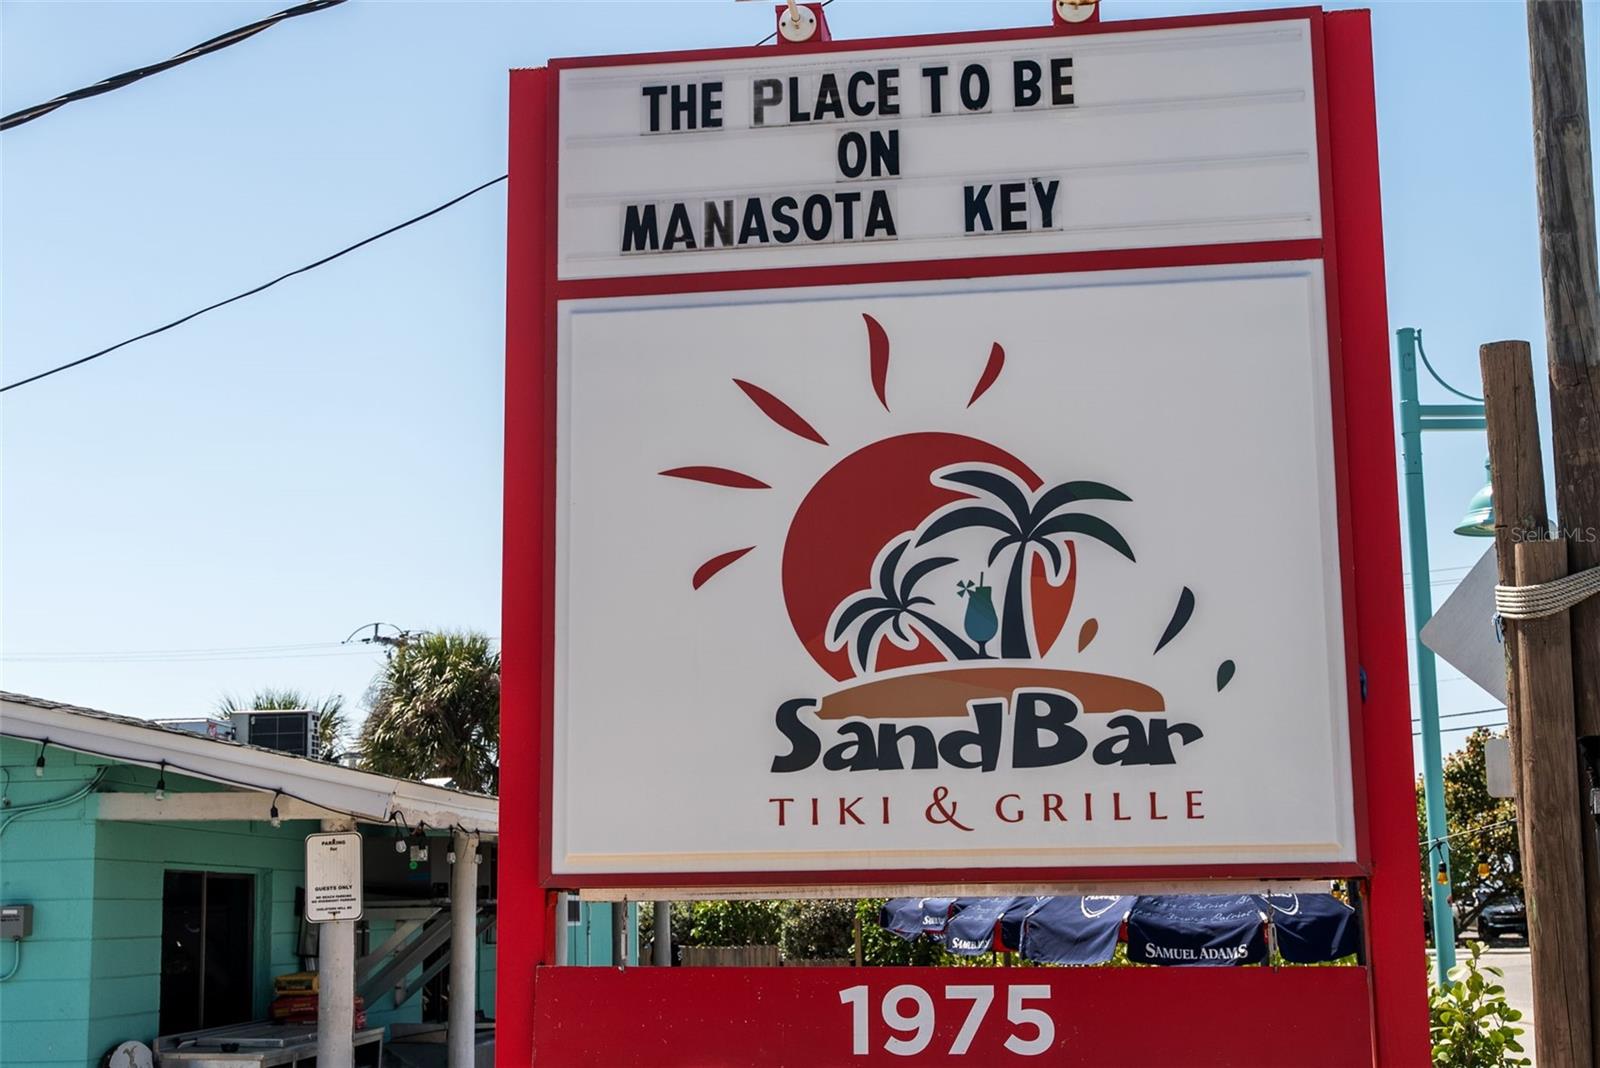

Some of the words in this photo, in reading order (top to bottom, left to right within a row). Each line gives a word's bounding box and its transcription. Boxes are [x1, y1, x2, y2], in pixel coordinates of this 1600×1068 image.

[642, 81, 723, 132] THE
[754, 68, 900, 126] PLACE
[922, 63, 991, 114] TO
[1013, 57, 1074, 108] BE
[838, 129, 900, 179] ON
[622, 189, 897, 252] MANASOTA
[964, 180, 1060, 232] KEY
[769, 692, 1205, 774] SandBar
[769, 796, 891, 827] TIKI
[925, 785, 976, 832] &
[995, 790, 1206, 823] GRILLE
[321, 838, 346, 847] PARKING
[1145, 942, 1198, 959] SAMUEL
[1200, 943, 1249, 960] ADAMS
[838, 983, 1056, 1057] 1975
